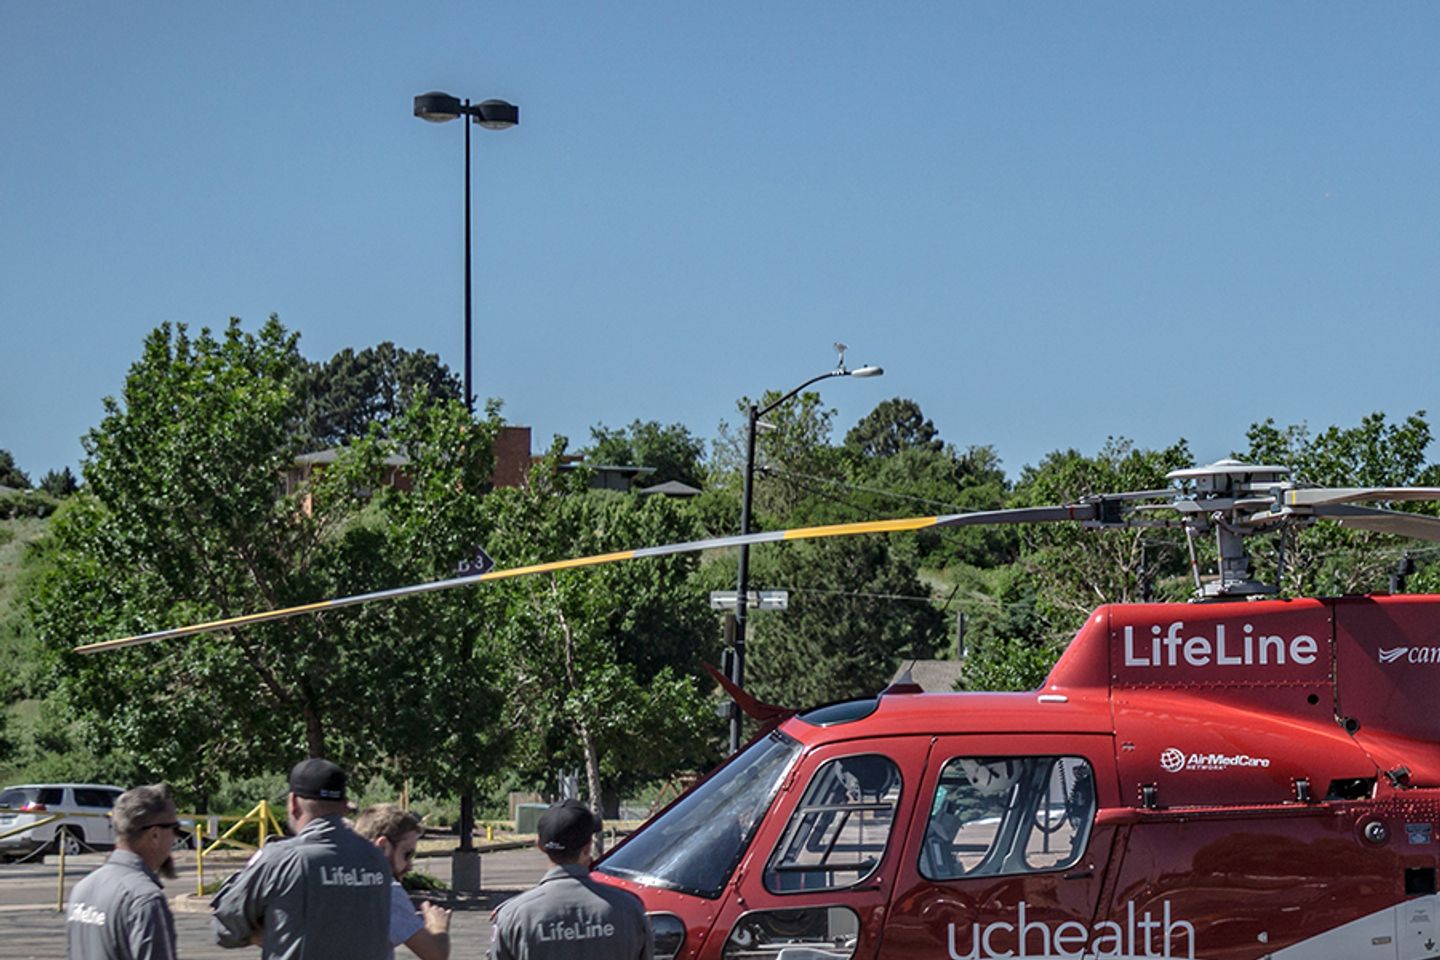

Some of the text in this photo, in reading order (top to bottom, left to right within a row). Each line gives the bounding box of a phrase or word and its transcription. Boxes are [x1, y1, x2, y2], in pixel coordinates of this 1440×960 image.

[1123, 622, 1318, 667] LifeLine
[1187, 754, 1270, 767] AirMedCare
[320, 865, 384, 886] LifeLine
[537, 922, 615, 942] LifeLine
[947, 900, 1196, 960] uchealth
